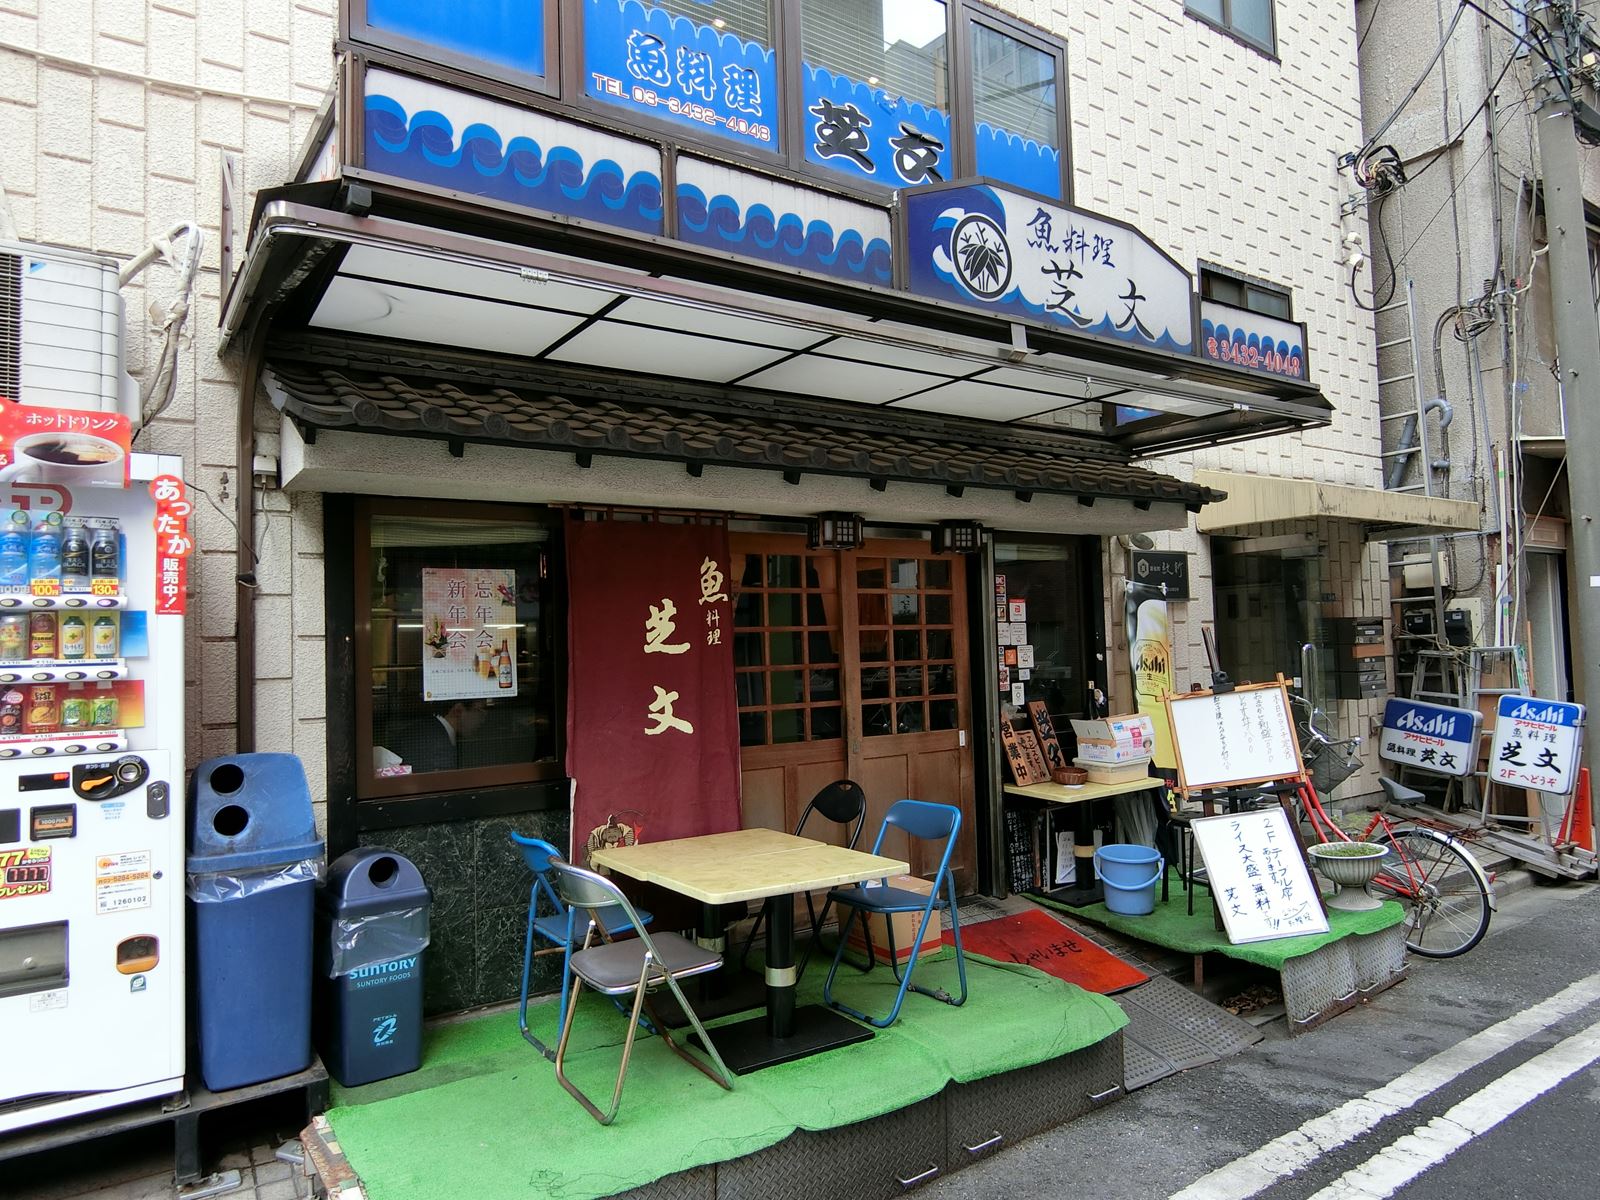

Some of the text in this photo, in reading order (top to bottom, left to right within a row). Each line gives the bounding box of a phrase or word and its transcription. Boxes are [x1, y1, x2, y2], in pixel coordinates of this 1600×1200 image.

[627, 29, 762, 116] 魚料理
[592, 71, 771, 143] TEL 03-3432-4048
[1026, 207, 1116, 268] 魚料理
[1041, 259, 1156, 341] 芝文
[1221, 339, 1300, 377] 3432-4048
[26, 412, 119, 431] ホットドリンク
[154, 478, 191, 555] あったか
[447, 580, 467, 649] 新年会
[474, 580, 494, 649] 忘年会
[698, 556, 729, 646] 魚料理
[643, 598, 694, 735] 芝文
[1135, 654, 1166, 675] Asahi
[1396, 707, 1456, 738] Asahi
[1510, 702, 1565, 724] Asahi
[1511, 727, 1557, 744] 魚料理
[1514, 719, 1558, 732] アサヒビール
[1001, 720, 1028, 780] 営業中
[1403, 732, 1445, 747] アサヒビール
[1500, 740, 1562, 774] 芝文
[356, 971, 411, 989] SUNTORY FOODS
